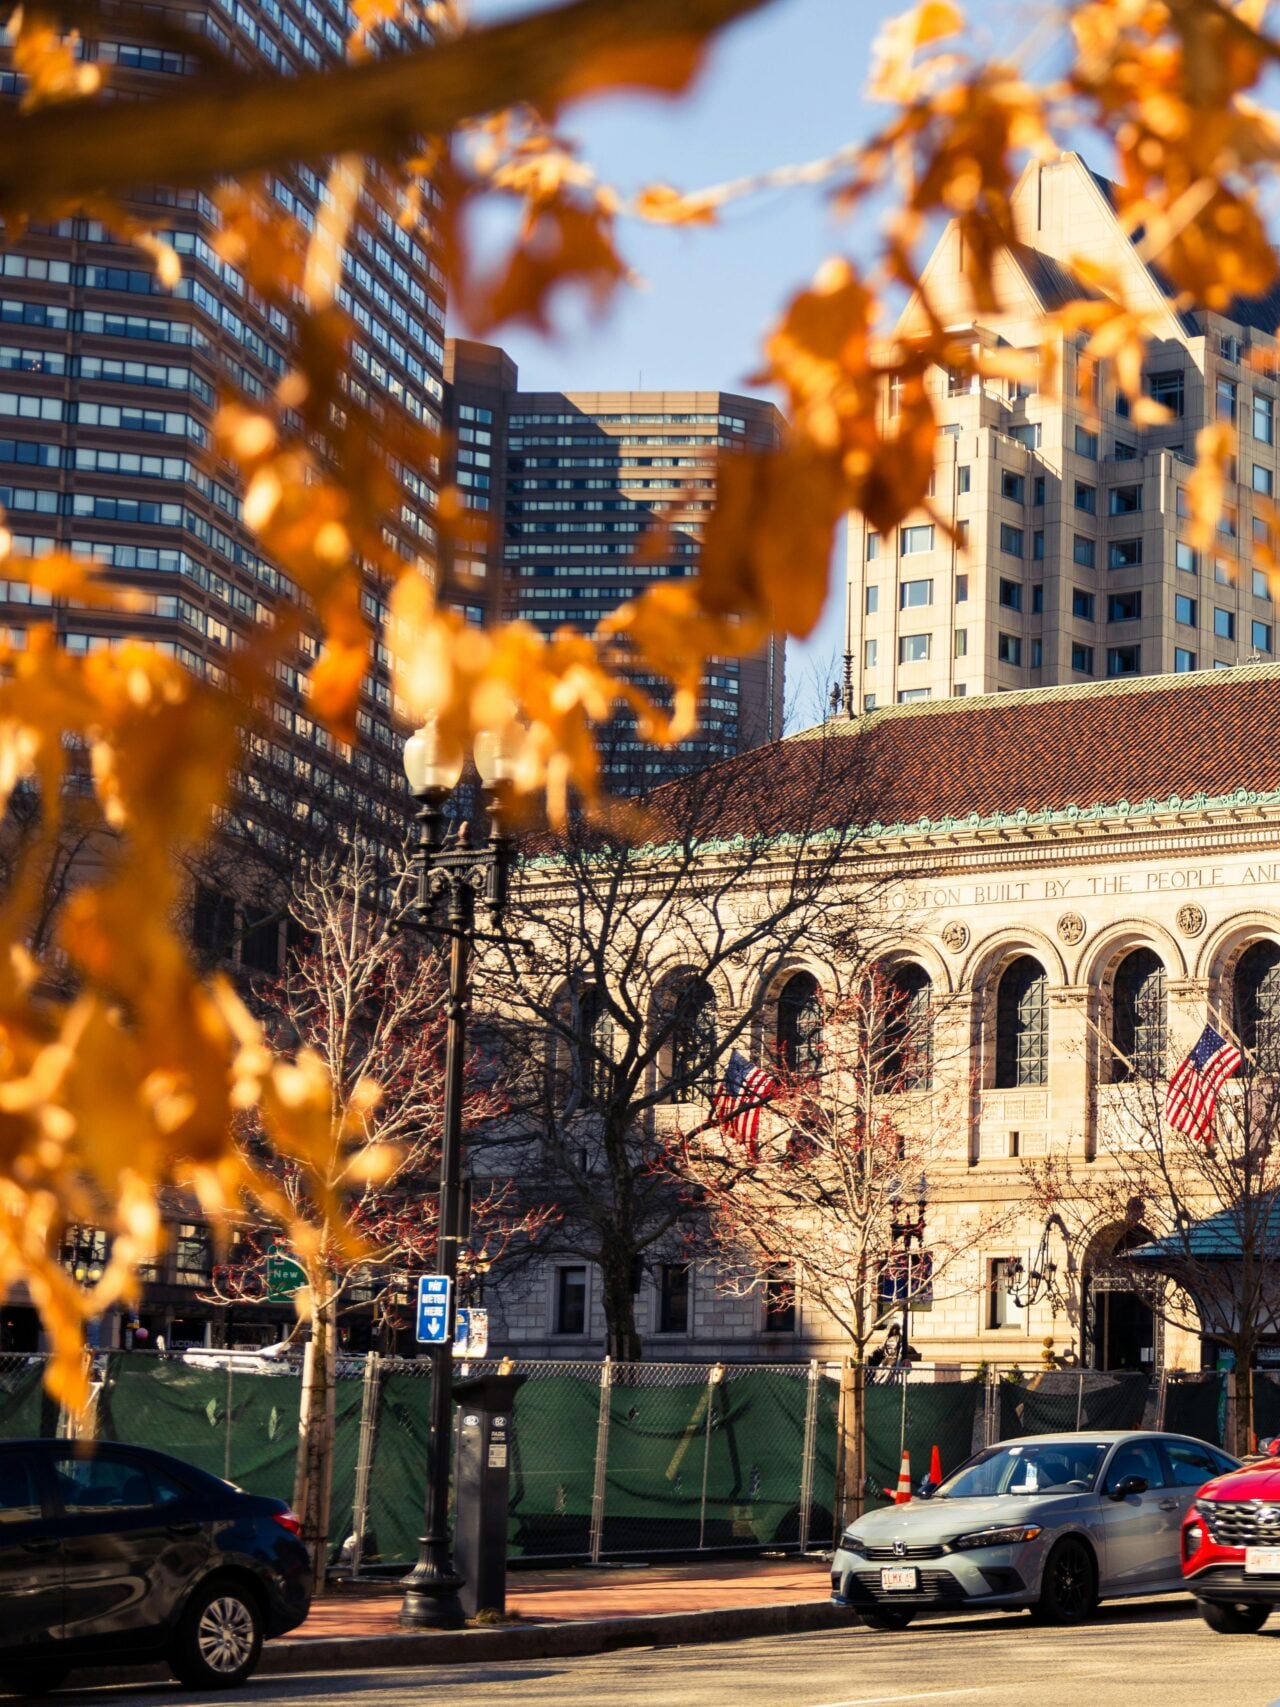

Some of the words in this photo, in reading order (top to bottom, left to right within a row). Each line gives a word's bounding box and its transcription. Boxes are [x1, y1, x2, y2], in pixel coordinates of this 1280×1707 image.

[879, 888, 961, 910] BOSTON
[975, 883, 1029, 902] BUILT
[1045, 879, 1071, 897] BY
[1088, 875, 1133, 895] THE
[1147, 868, 1225, 891] PEOPLE
[273, 1269, 299, 1279] New
[171, 1339, 204, 1348] UCONN
